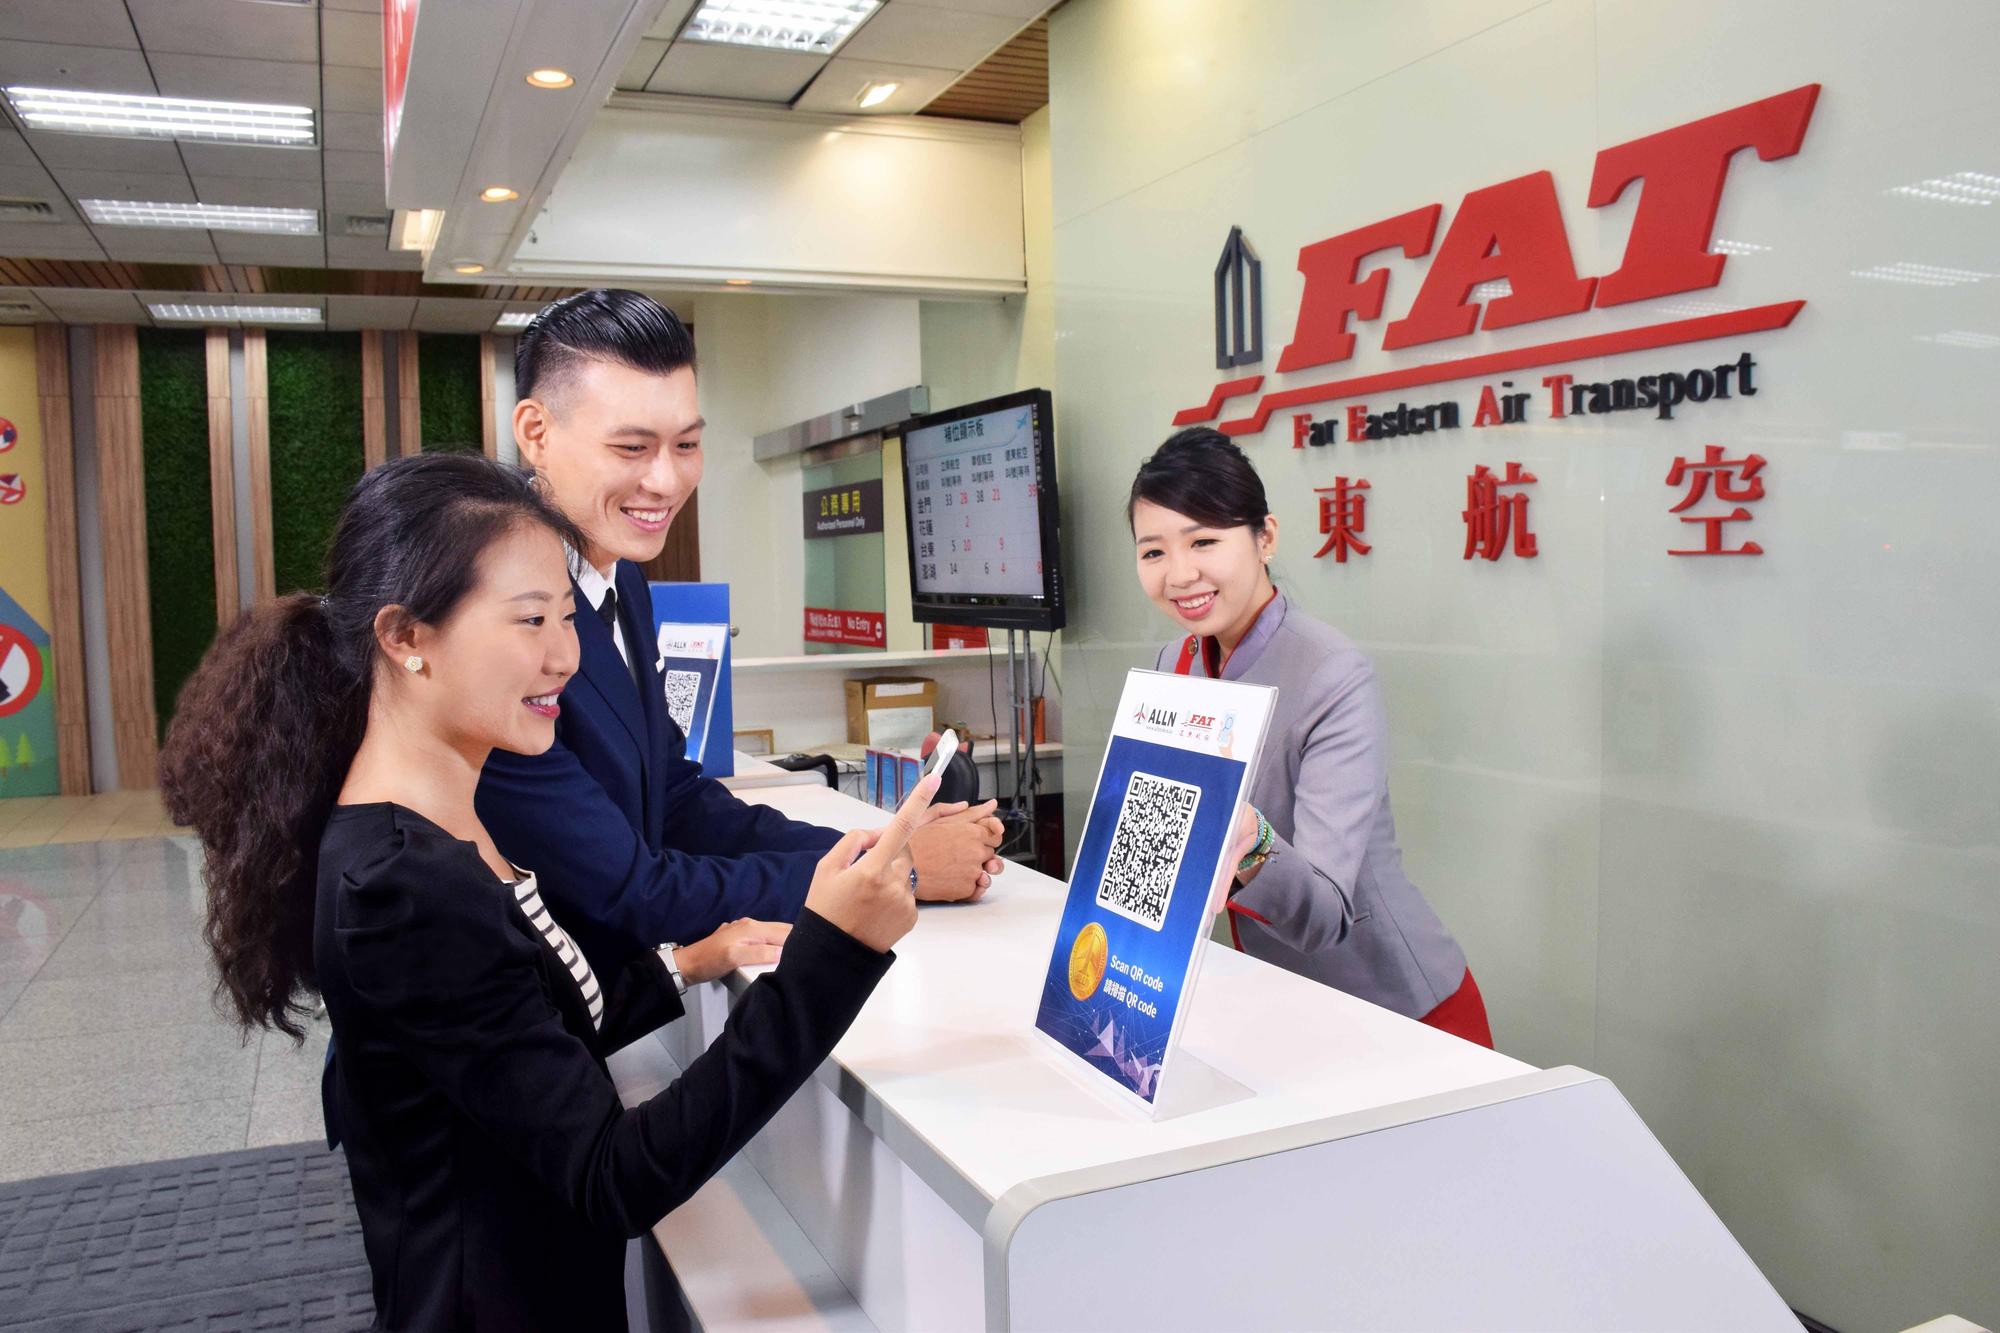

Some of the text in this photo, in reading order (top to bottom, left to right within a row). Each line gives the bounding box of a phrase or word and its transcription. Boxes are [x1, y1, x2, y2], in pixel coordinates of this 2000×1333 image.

[1276, 83, 1821, 374] FAT
[1292, 352, 1758, 449] Far Eastern Air Transport
[917, 497, 931, 514] 金門
[945, 493, 952, 506] 33
[847, 616, 855, 629] No
[856, 617, 870, 634] Entry
[1147, 708, 1177, 727] ALLN
[1189, 714, 1216, 727] FAT
[1110, 954, 1164, 992] Scan QR code
[1126, 991, 1138, 1008] QR
[1137, 1000, 1157, 1018] code
